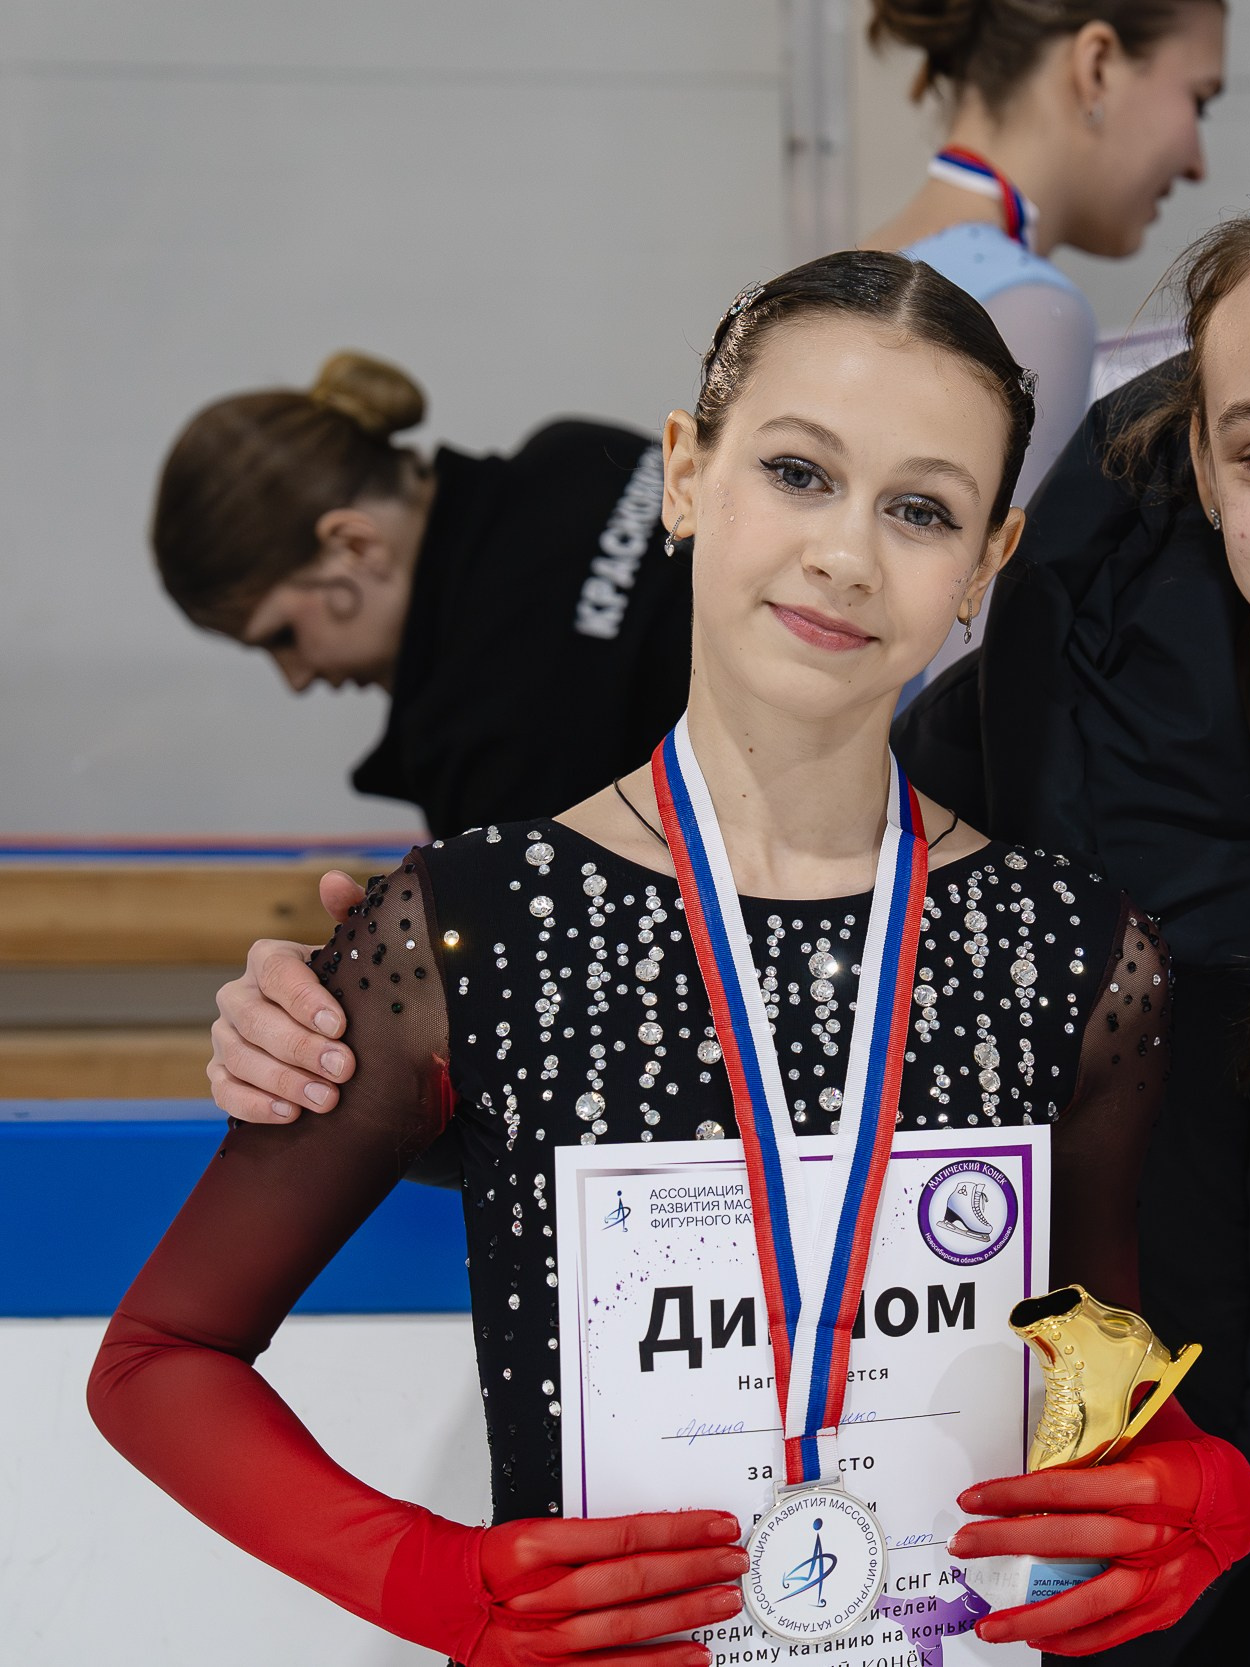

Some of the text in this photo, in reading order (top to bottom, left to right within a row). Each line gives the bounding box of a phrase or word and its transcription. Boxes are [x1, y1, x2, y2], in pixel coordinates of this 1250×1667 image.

[650, 1185, 743, 1200] АССОЦИАЦИЯ
[651, 1200, 720, 1214] РАЗВИТИЯ
[651, 1214, 731, 1228] ФИГУРНОГО
[925, 1232, 960, 1262] Новосибирская
[994, 1226, 1012, 1251] Кольцово
[638, 1282, 976, 1373] Диом
[748, 1465, 772, 1480] за
[768, 1497, 826, 1531] РАЗВИТИЯ
[830, 1498, 878, 1556] МАССОВОГО
[751, 1532, 776, 1616] АССОЦИАЦИЯ
[896, 1573, 932, 1592] СНГ
[834, 1559, 878, 1624] ФИГУРНОГО
[691, 1625, 754, 1644] среди
[777, 1615, 831, 1632] КАТАНИЯ
[882, 1628, 903, 1642] на
[912, 1617, 977, 1638] конька
